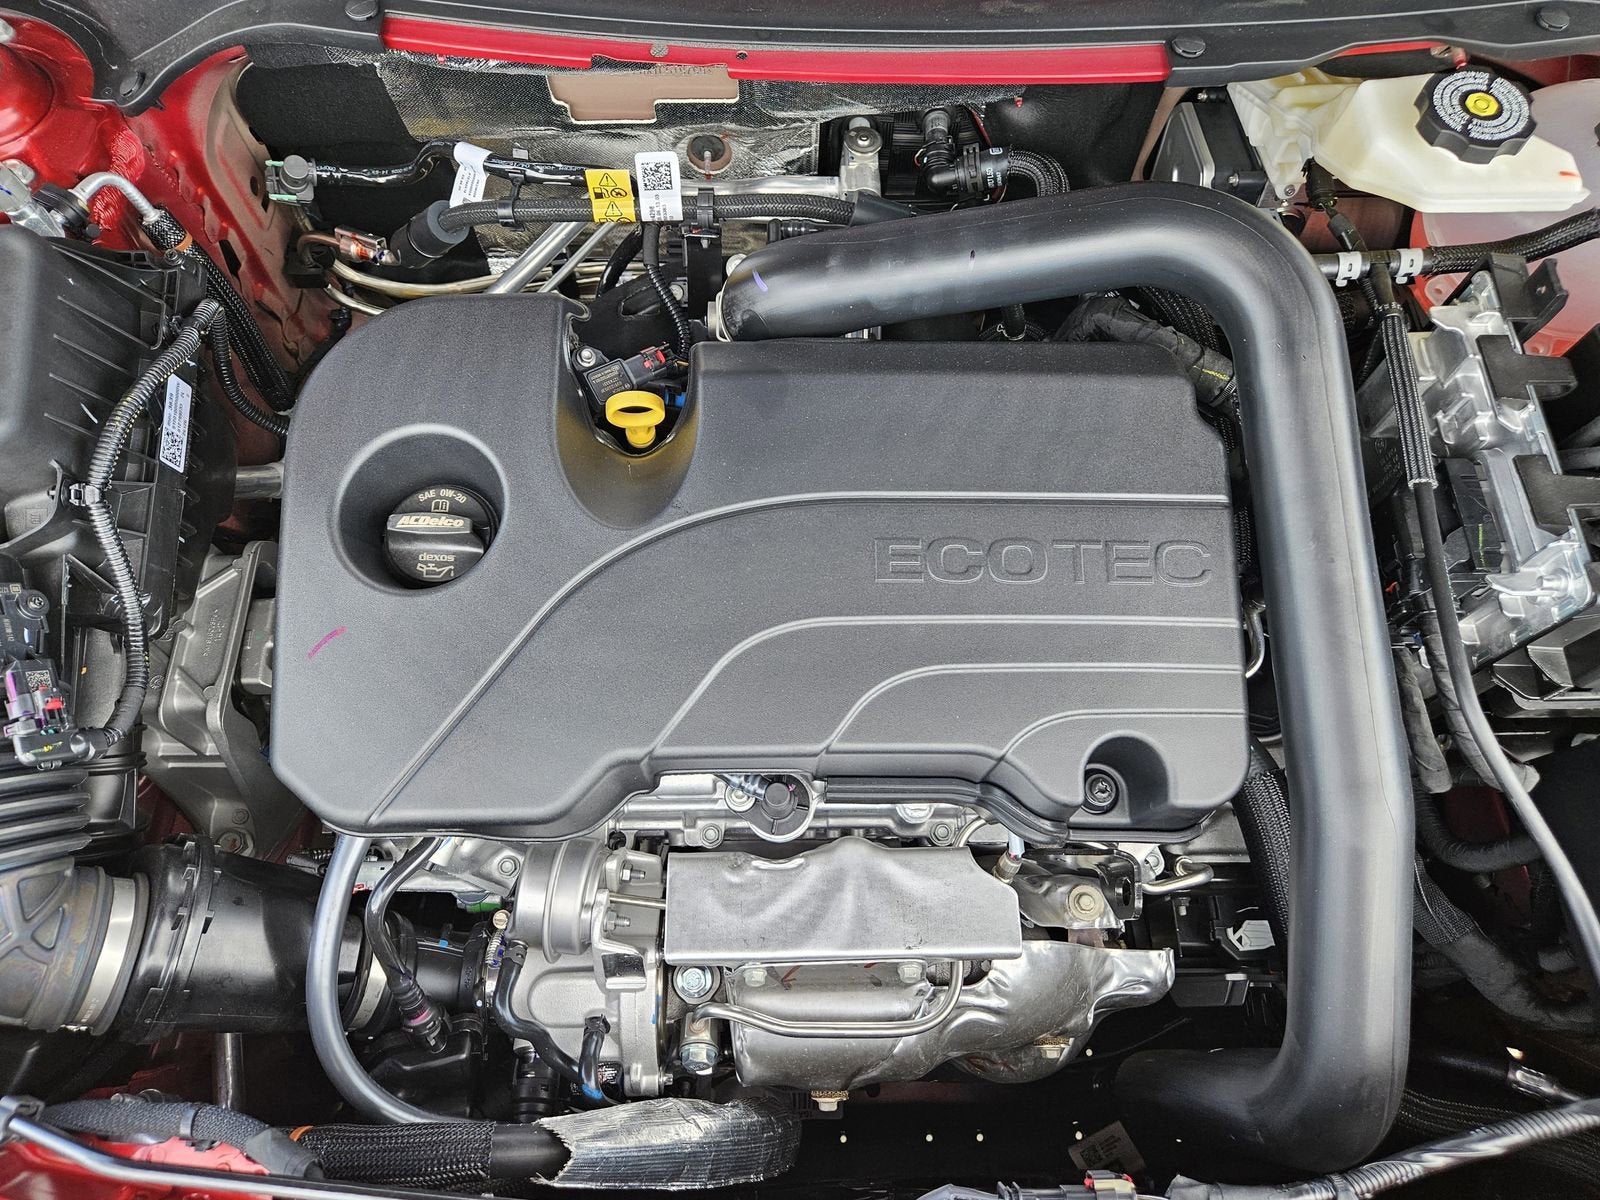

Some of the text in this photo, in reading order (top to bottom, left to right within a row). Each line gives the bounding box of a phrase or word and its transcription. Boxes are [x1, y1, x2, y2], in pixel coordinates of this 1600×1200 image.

[418, 488, 467, 504] SAE 0W-20
[397, 515, 465, 528] ACDelco
[418, 552, 455, 562] dexos
[874, 537, 1212, 587] ECOTEC
